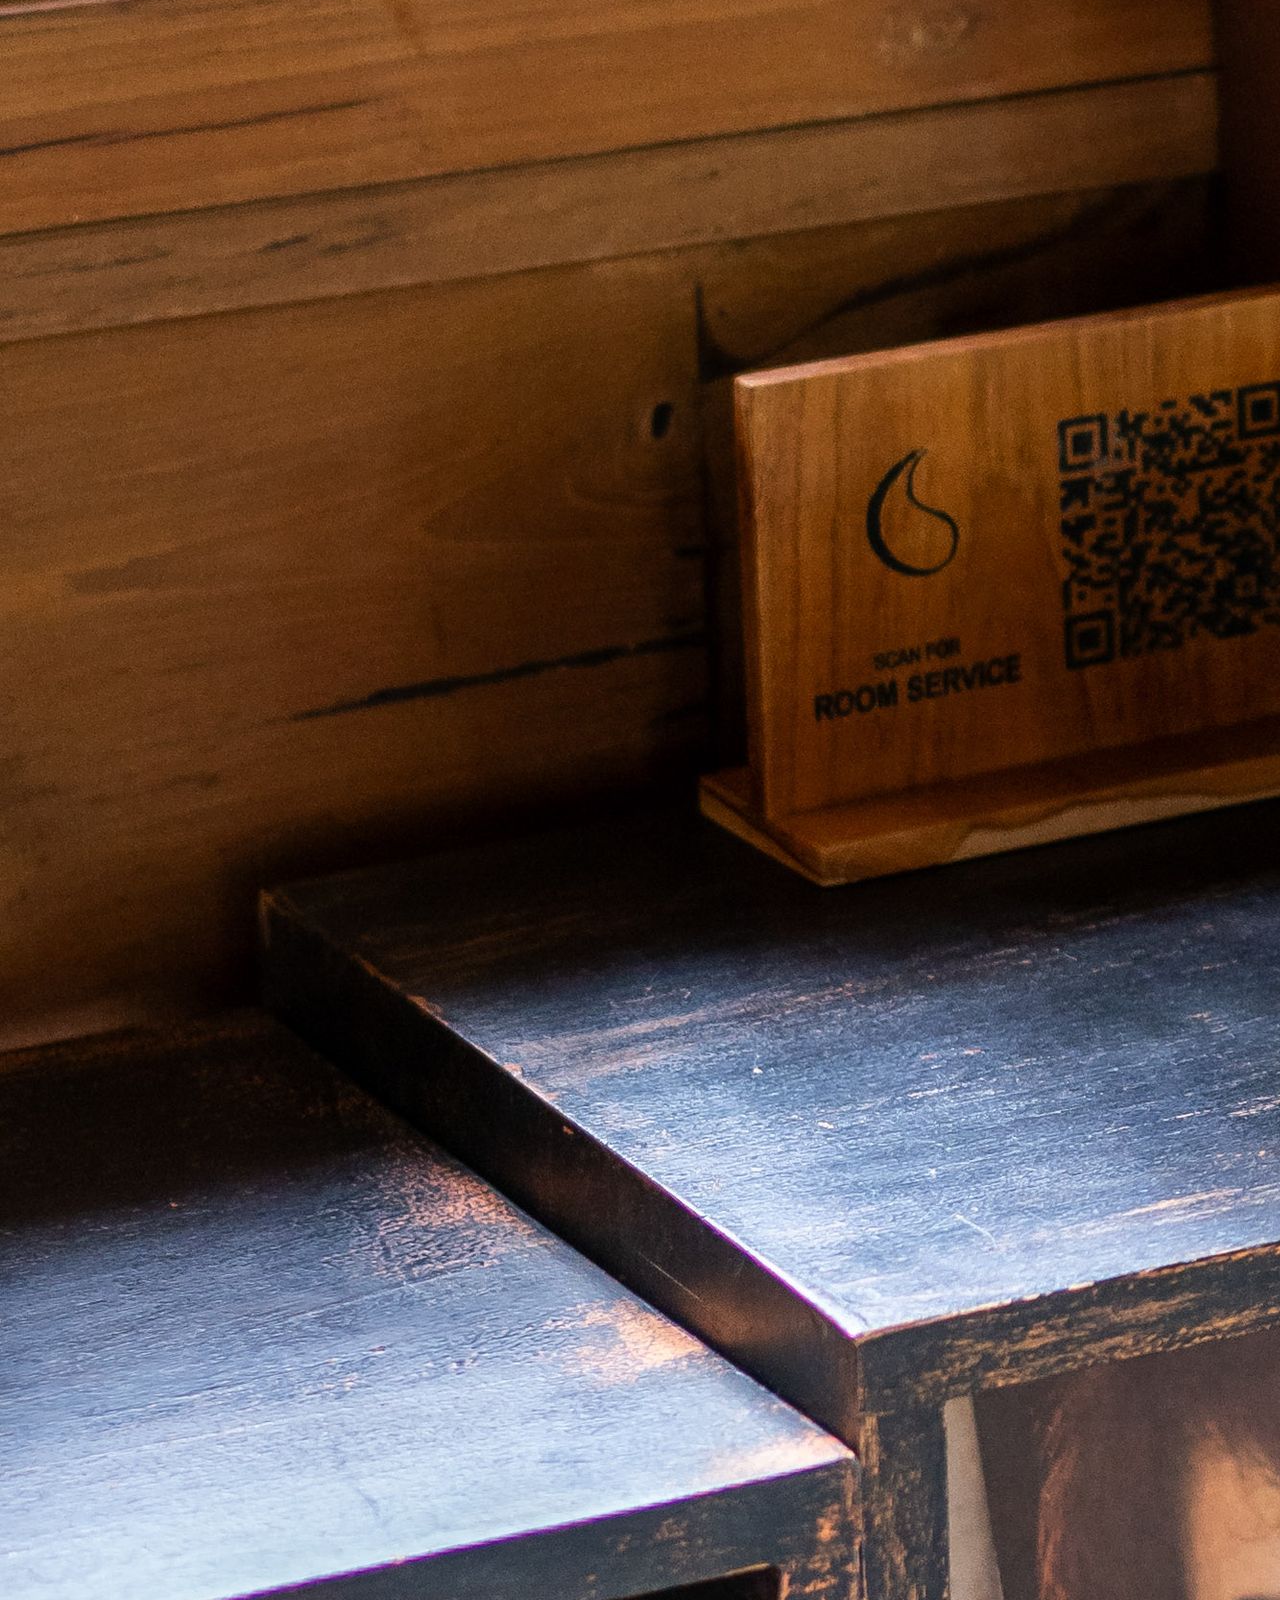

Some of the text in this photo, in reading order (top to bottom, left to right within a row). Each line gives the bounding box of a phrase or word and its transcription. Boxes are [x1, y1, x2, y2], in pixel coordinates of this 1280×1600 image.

[873, 637, 960, 670] SCAN FOR
[814, 654, 1021, 721] ROOM SERVICE
